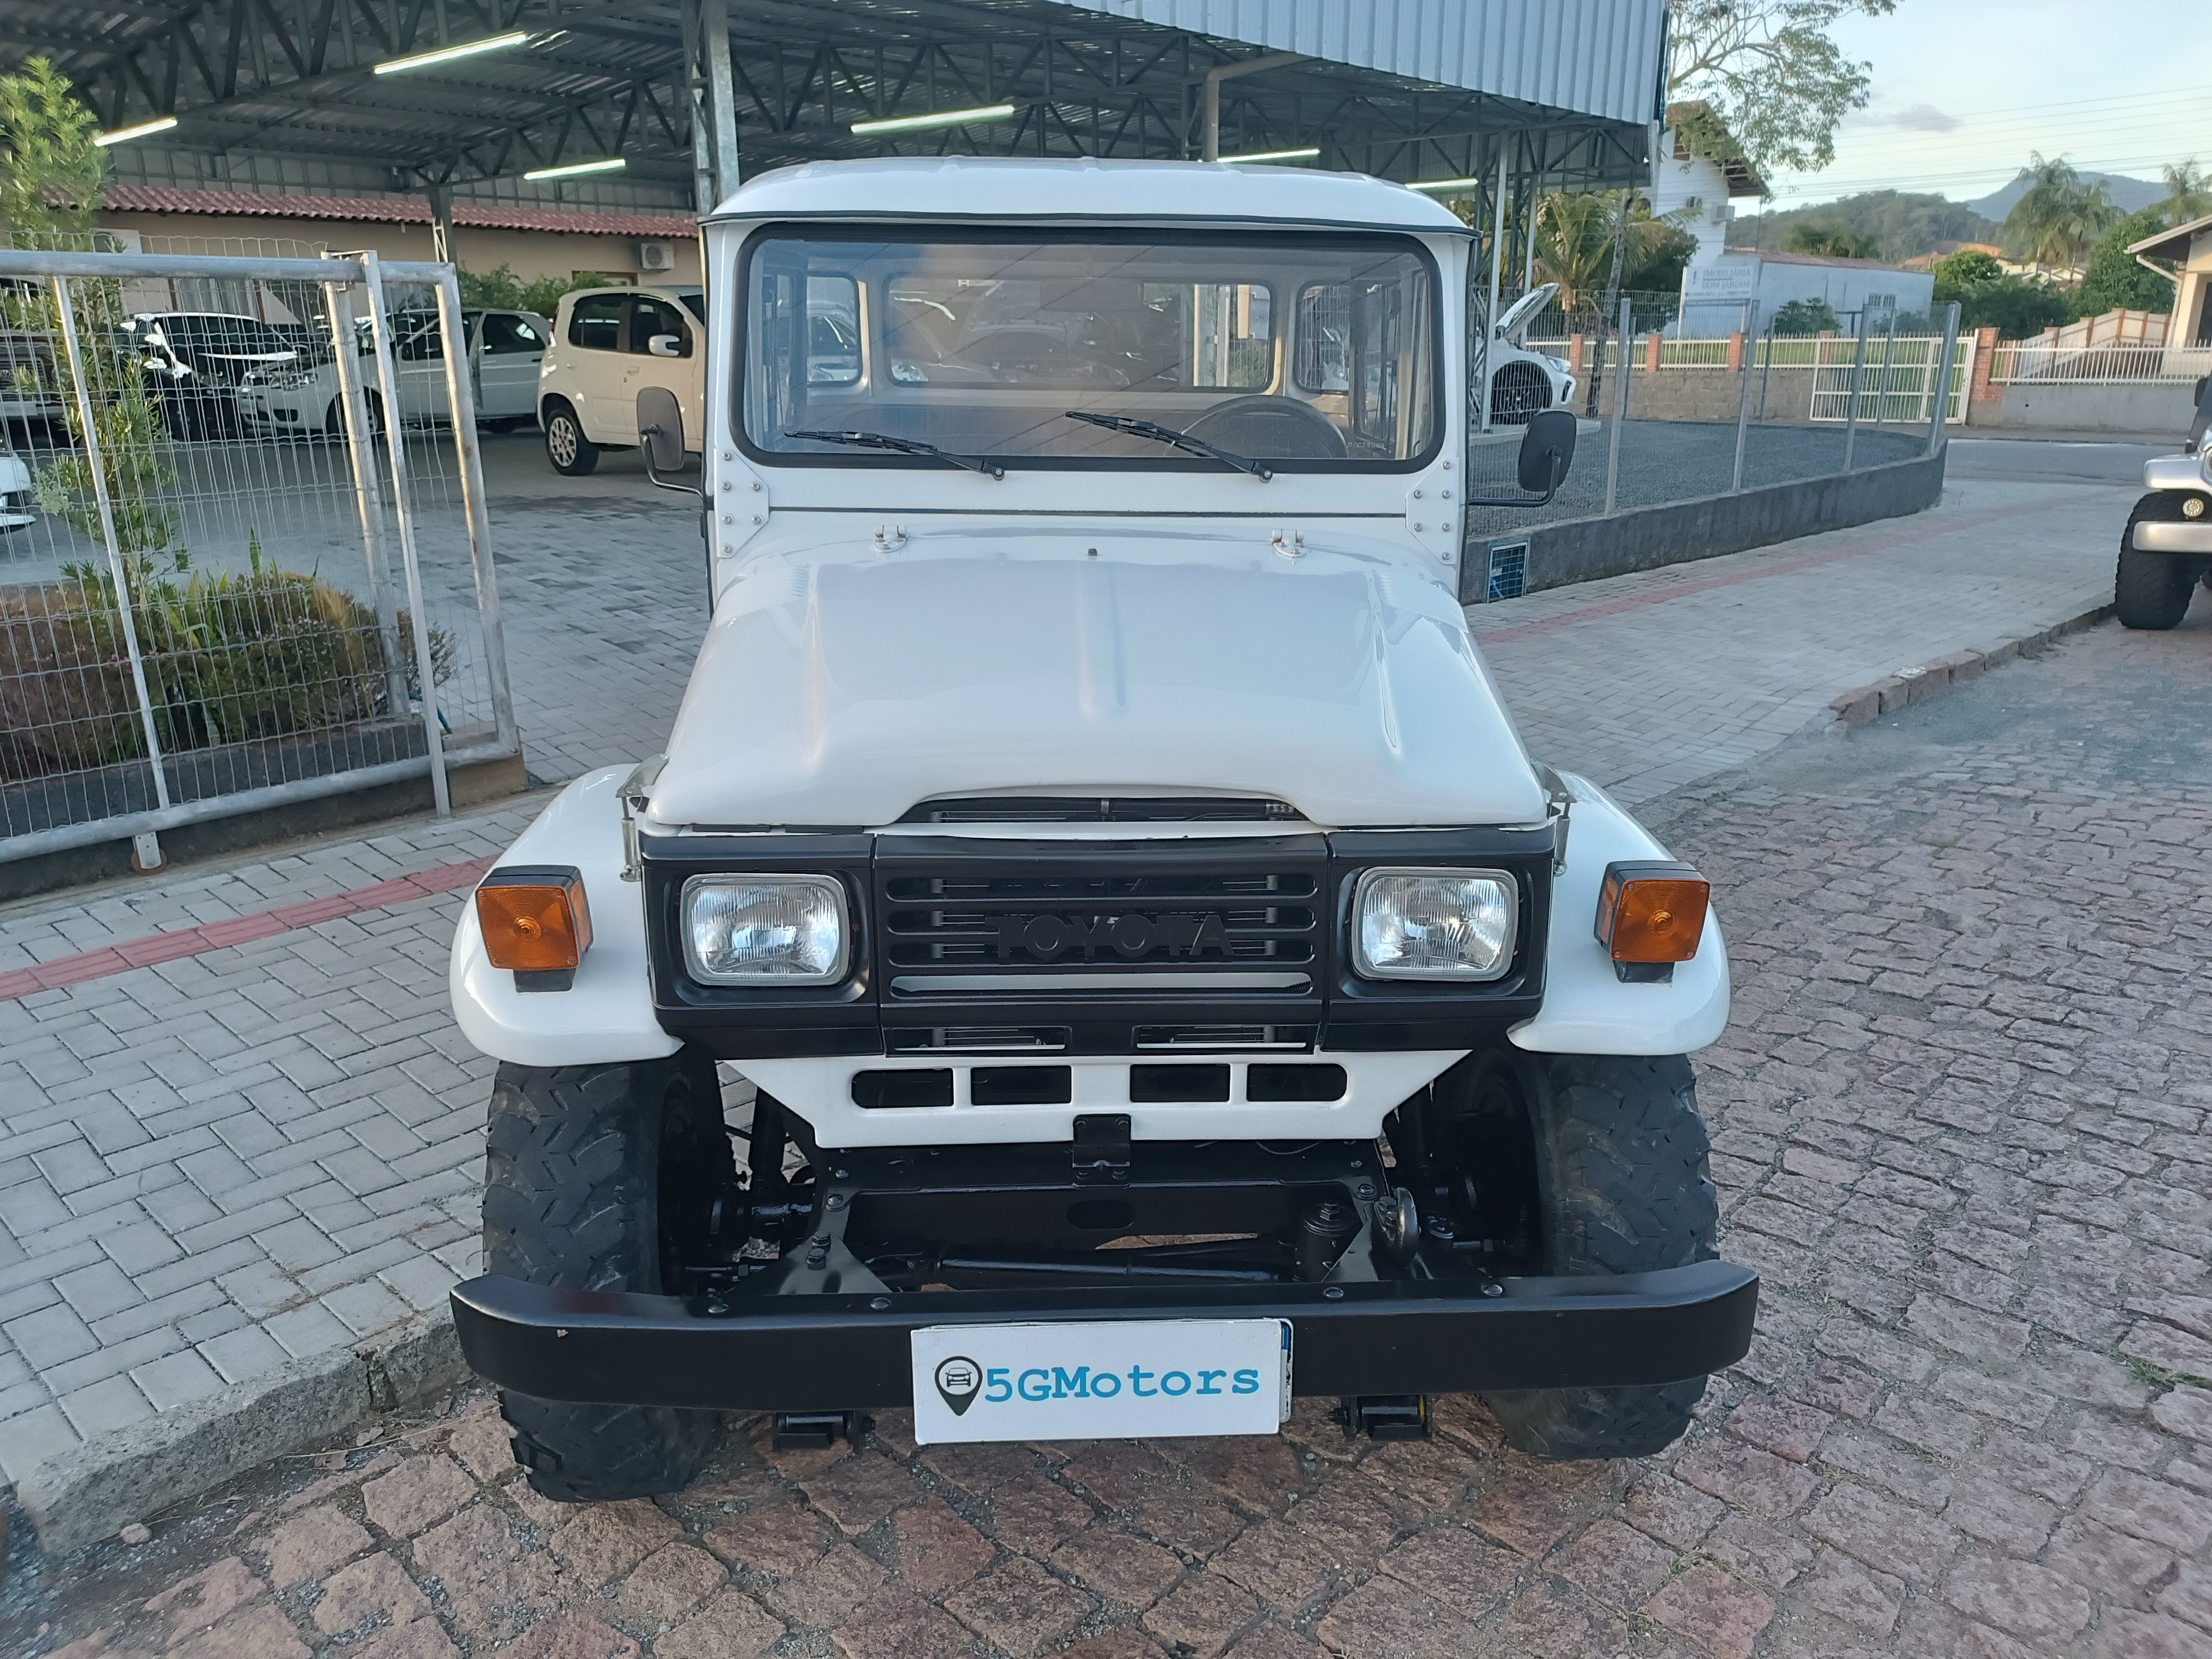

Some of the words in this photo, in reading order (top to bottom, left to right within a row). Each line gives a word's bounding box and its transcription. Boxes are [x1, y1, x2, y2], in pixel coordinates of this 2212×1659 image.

[1702, 280, 1720, 289] BOM
[1721, 280, 1750, 289] JARDIM
[984, 915, 1235, 958] TOYOTA
[984, 1365, 1260, 1402] 5GMotors
